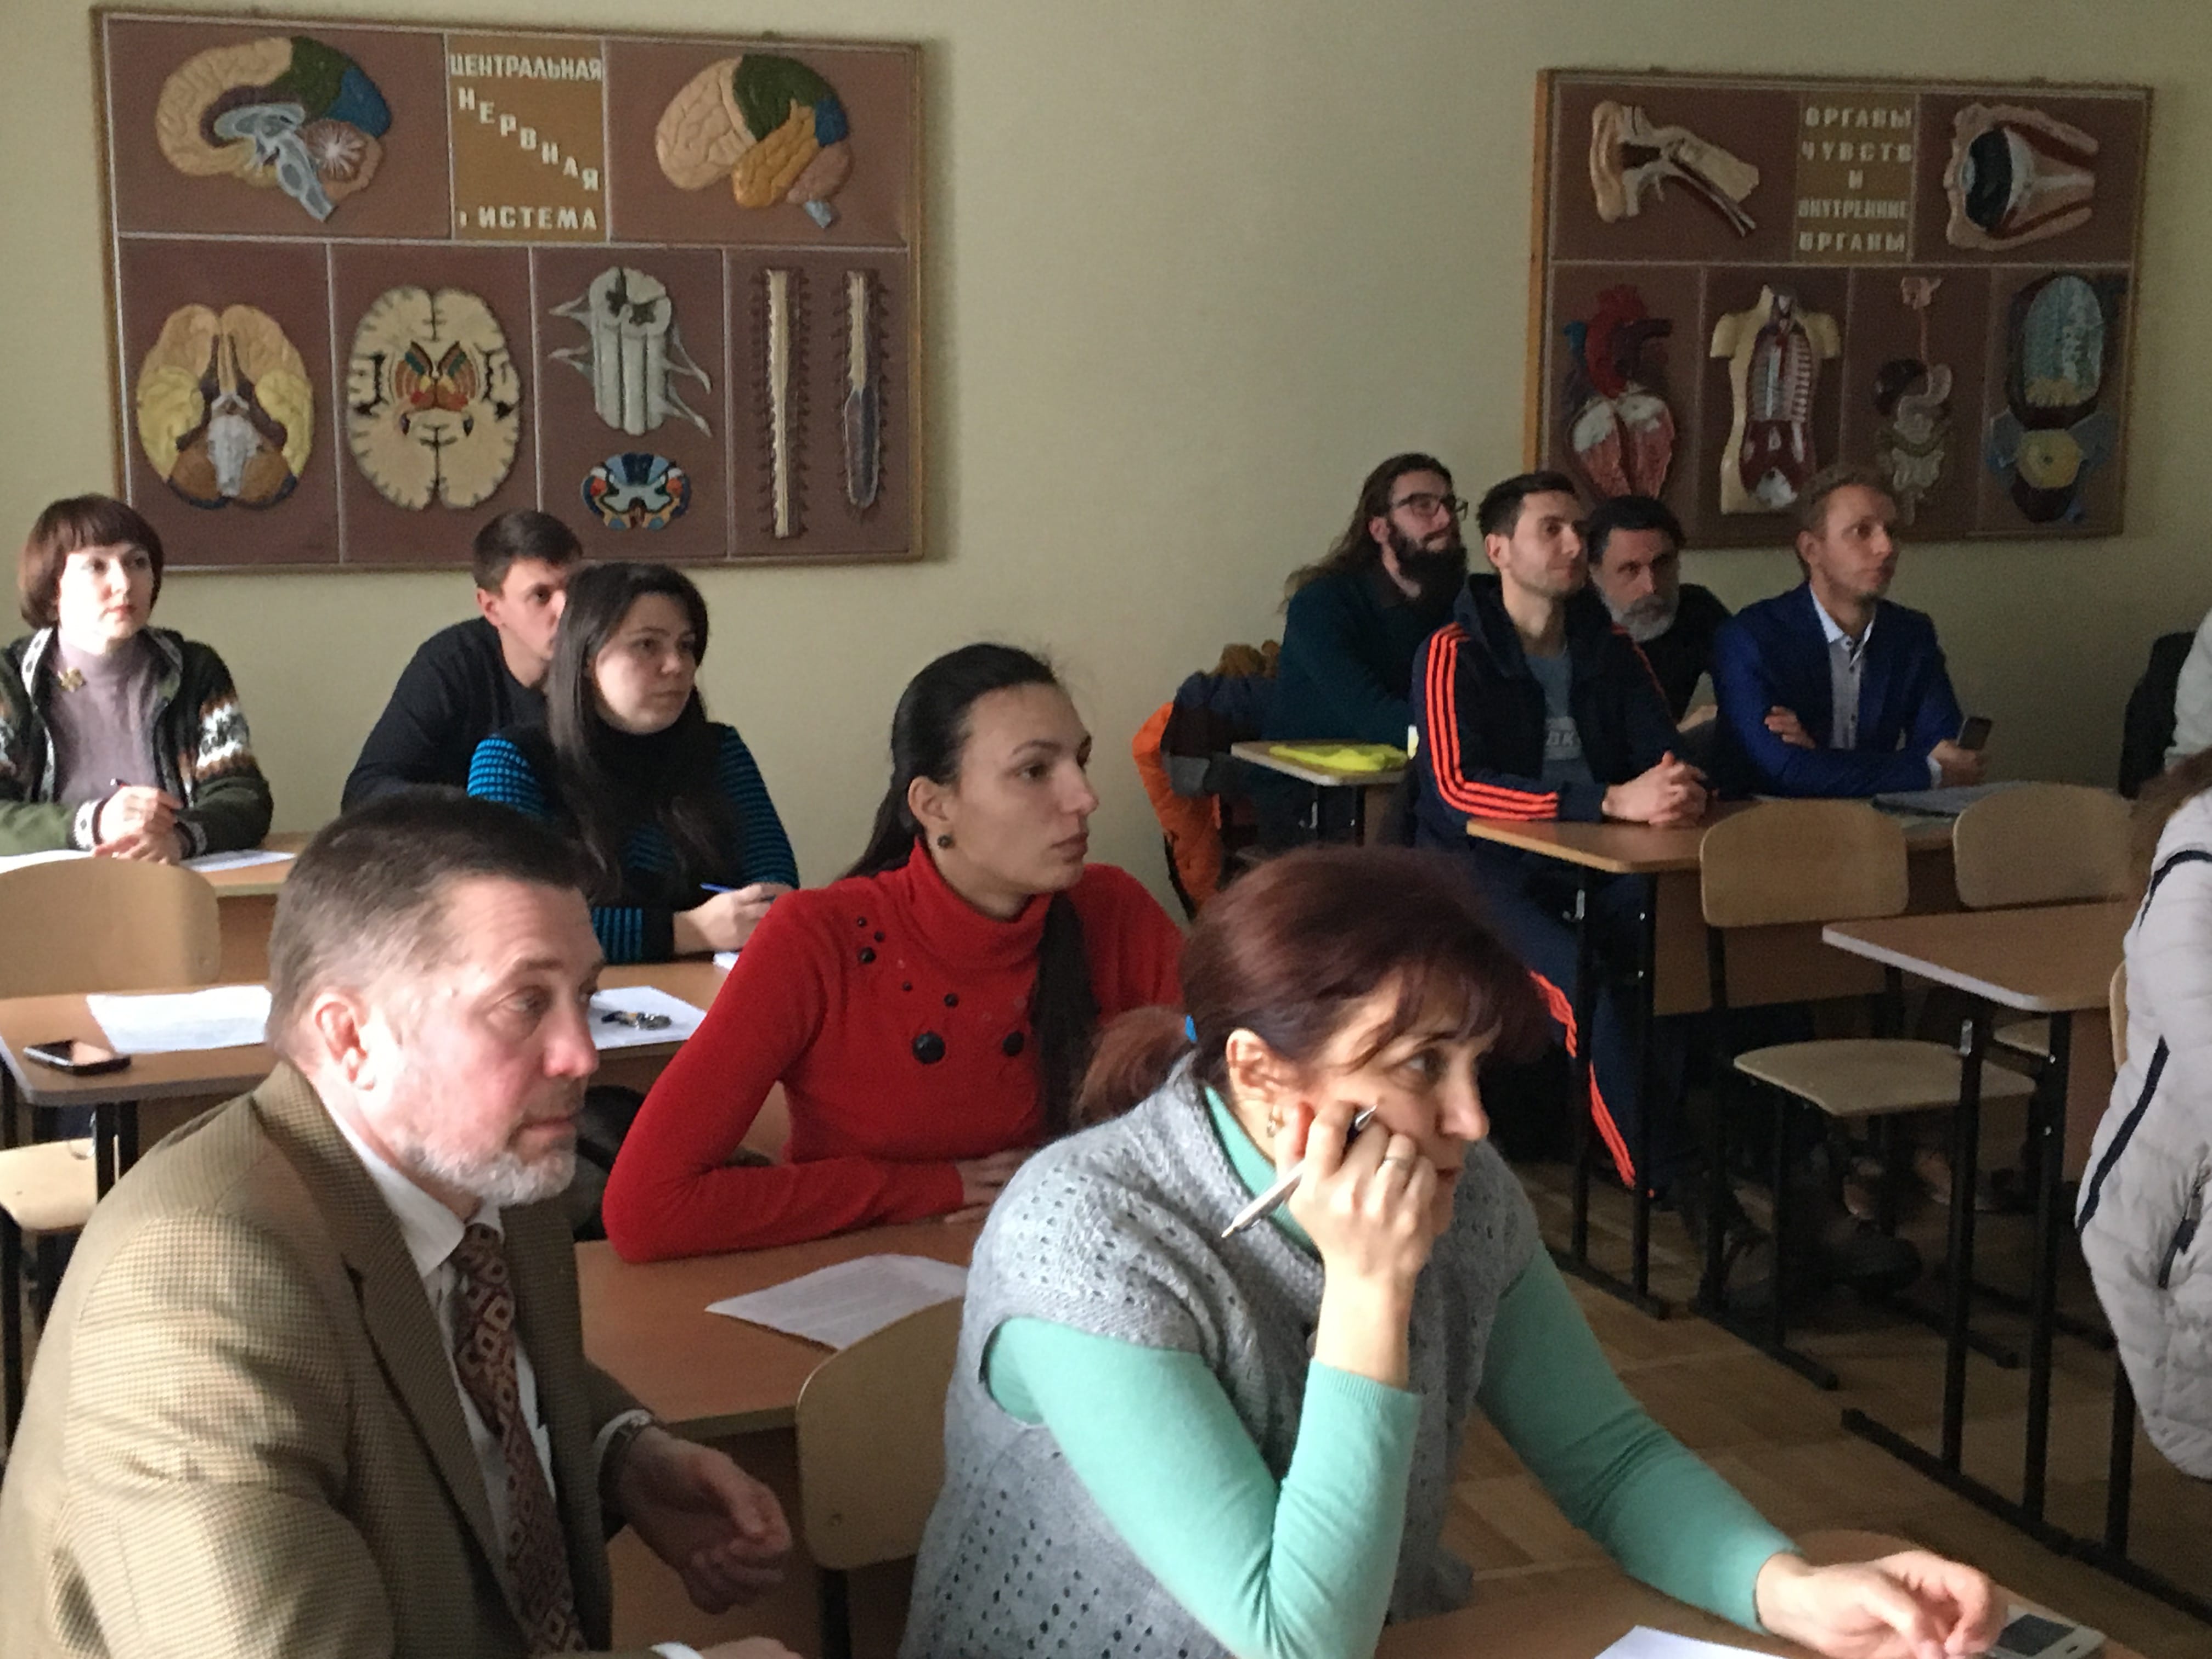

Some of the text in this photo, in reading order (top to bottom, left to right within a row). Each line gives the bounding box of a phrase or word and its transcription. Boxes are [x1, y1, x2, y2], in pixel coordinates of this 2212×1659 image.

[450, 53, 602, 81] ЦЕНТРАЛЬНАЯ
[1805, 106, 1912, 128] ОРГАНЫ
[458, 86, 599, 191] НЕРВНАЯ
